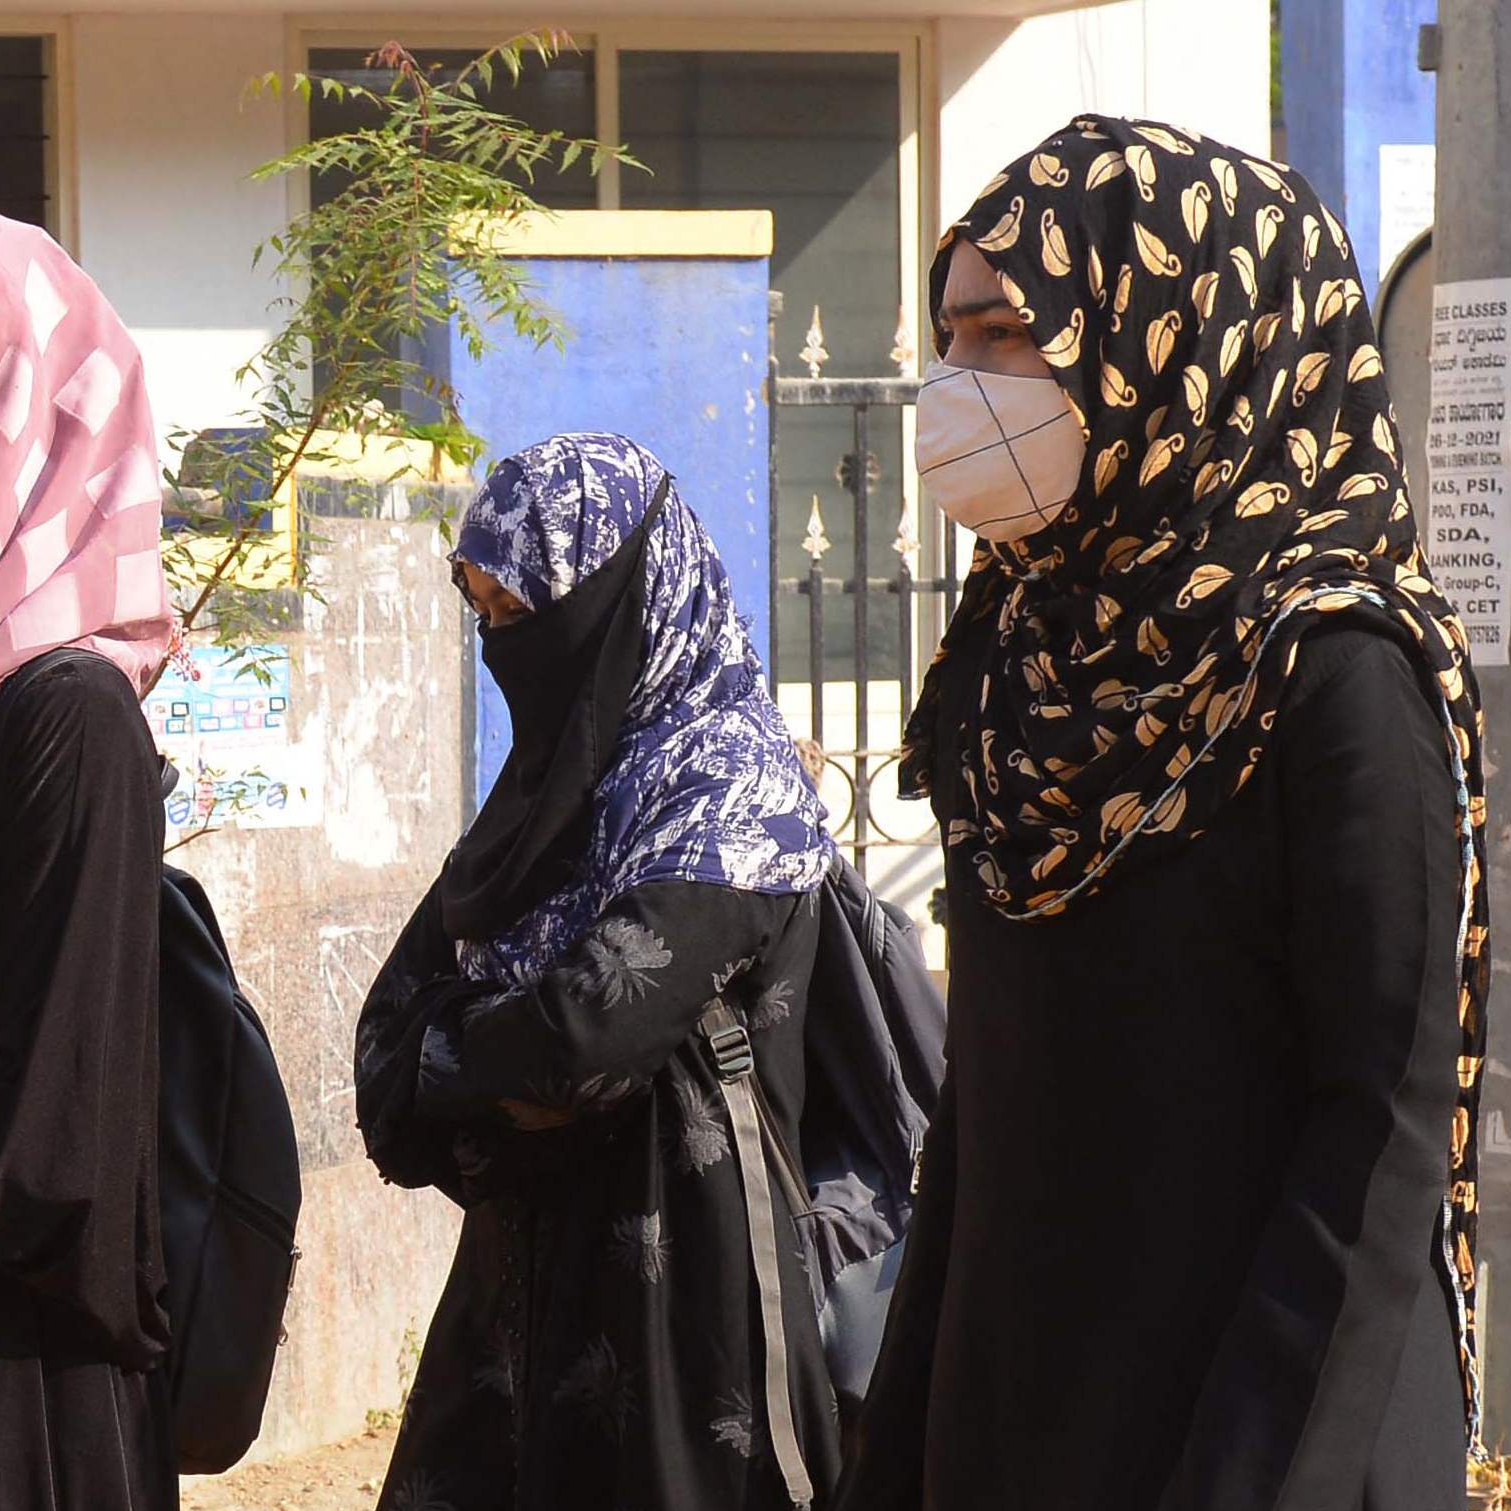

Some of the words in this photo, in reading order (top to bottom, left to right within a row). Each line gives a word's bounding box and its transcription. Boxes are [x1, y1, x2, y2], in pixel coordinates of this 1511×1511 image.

[1452, 301, 1507, 319] CLASSES
[1432, 479, 1460, 496] KAS,
[1467, 478, 1503, 495] PSI,
[1460, 503, 1495, 518] FDA,
[1437, 528, 1490, 544] SDA,
[1444, 575, 1501, 593] Group-C,
[1467, 599, 1500, 613] CET
